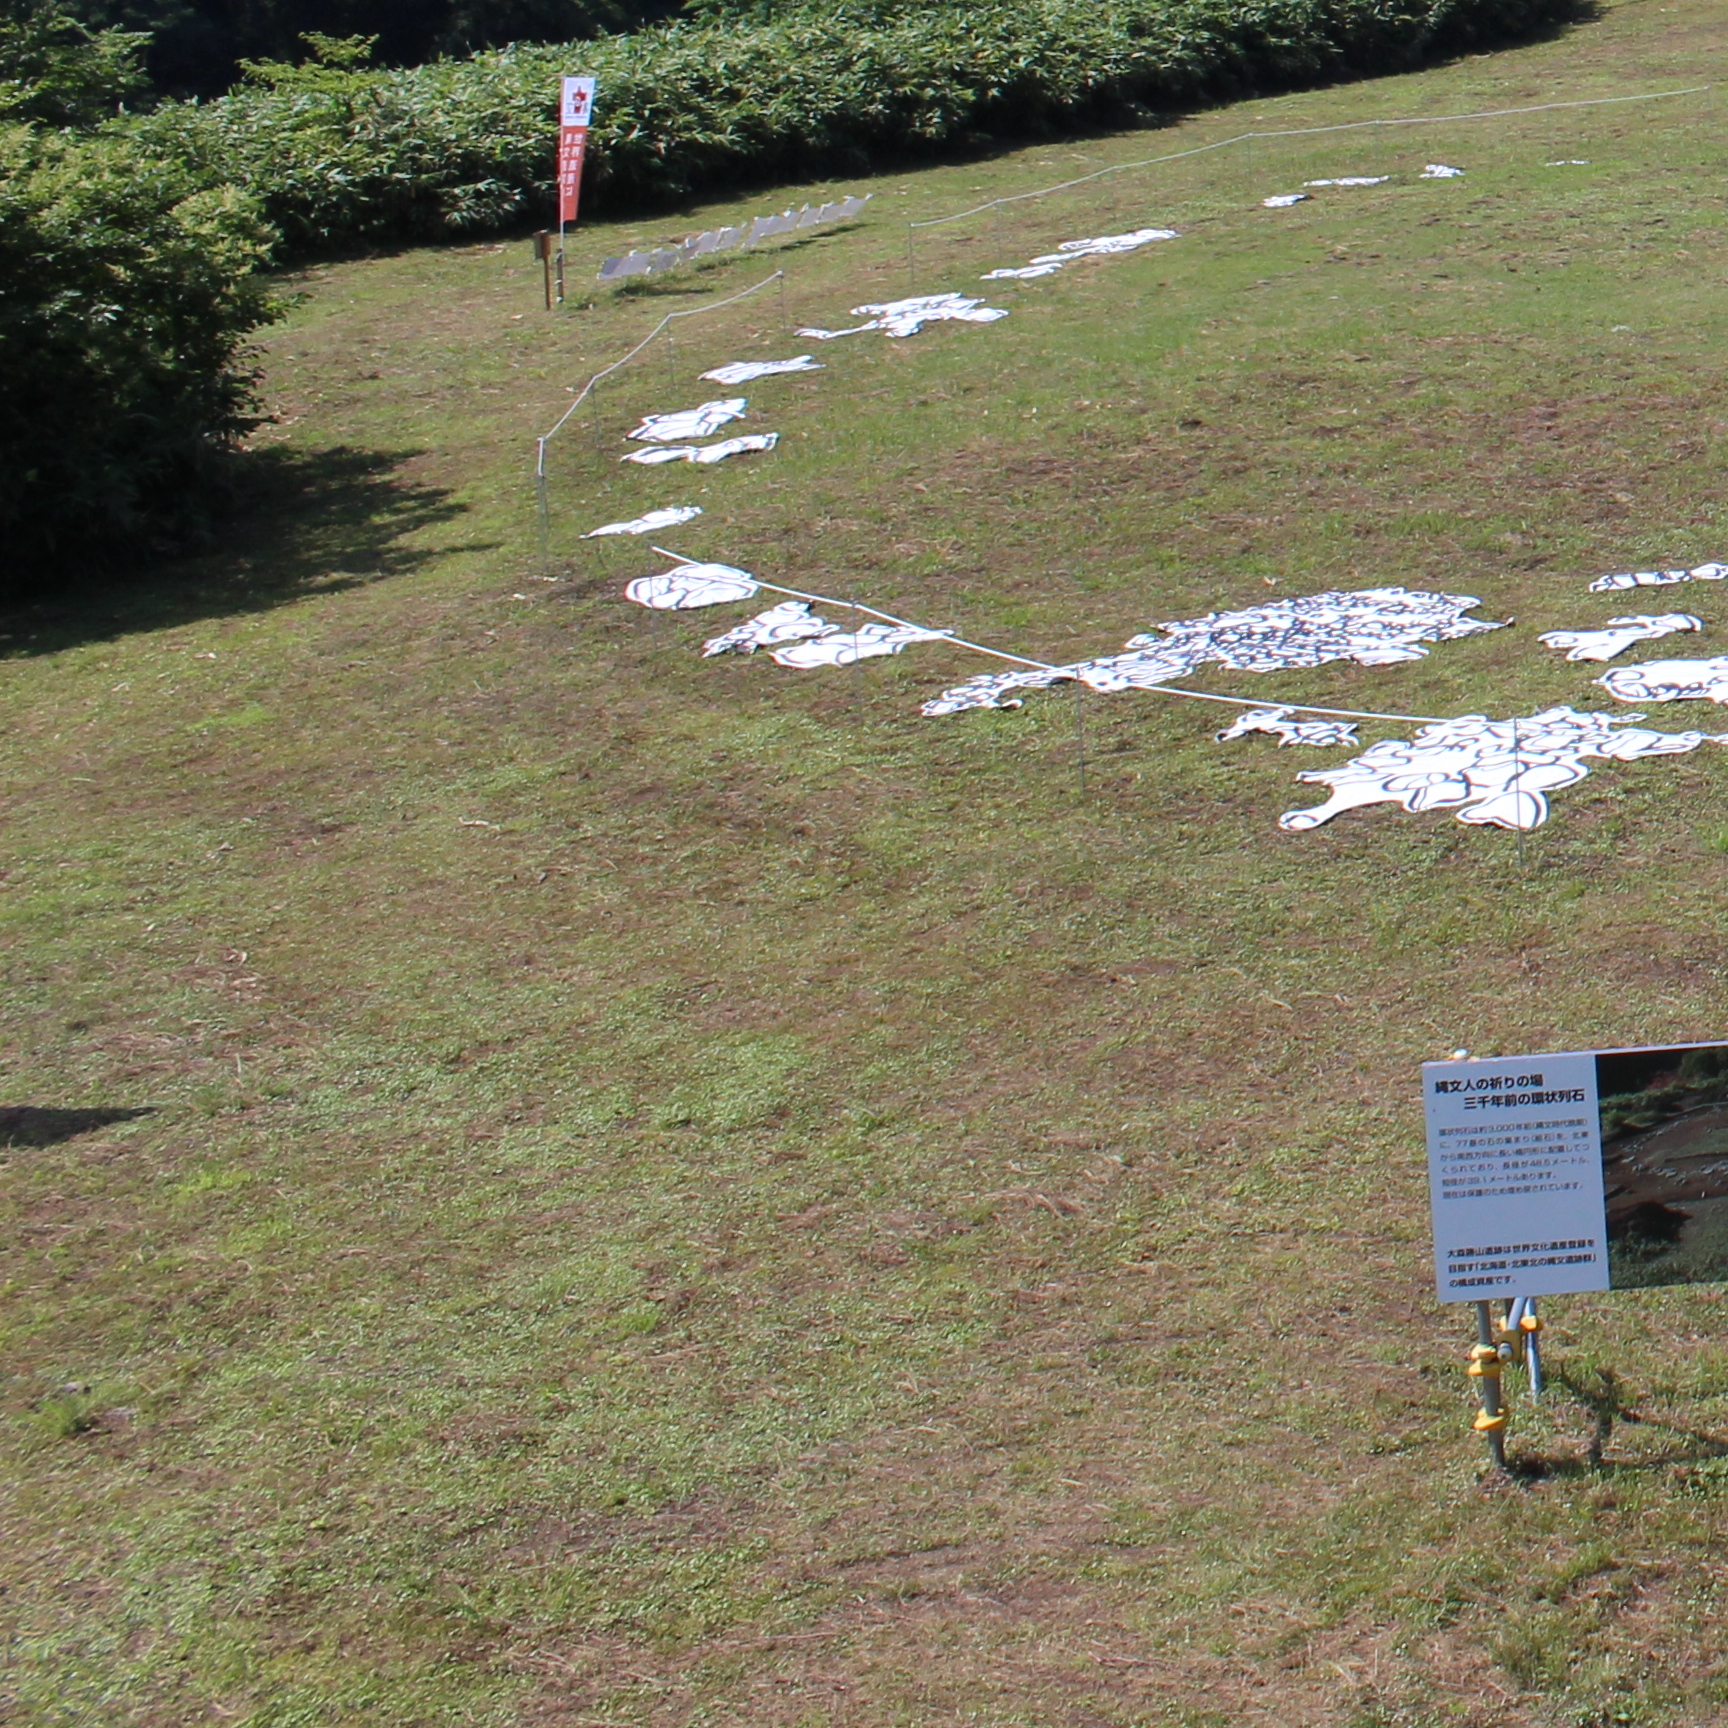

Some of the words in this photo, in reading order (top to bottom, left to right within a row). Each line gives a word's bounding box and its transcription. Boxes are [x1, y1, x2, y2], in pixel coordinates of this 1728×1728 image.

[1435, 1073, 1544, 1093] 縄文人の祈りの場
[1464, 1088, 1585, 1110] 三千年前の環状列石
